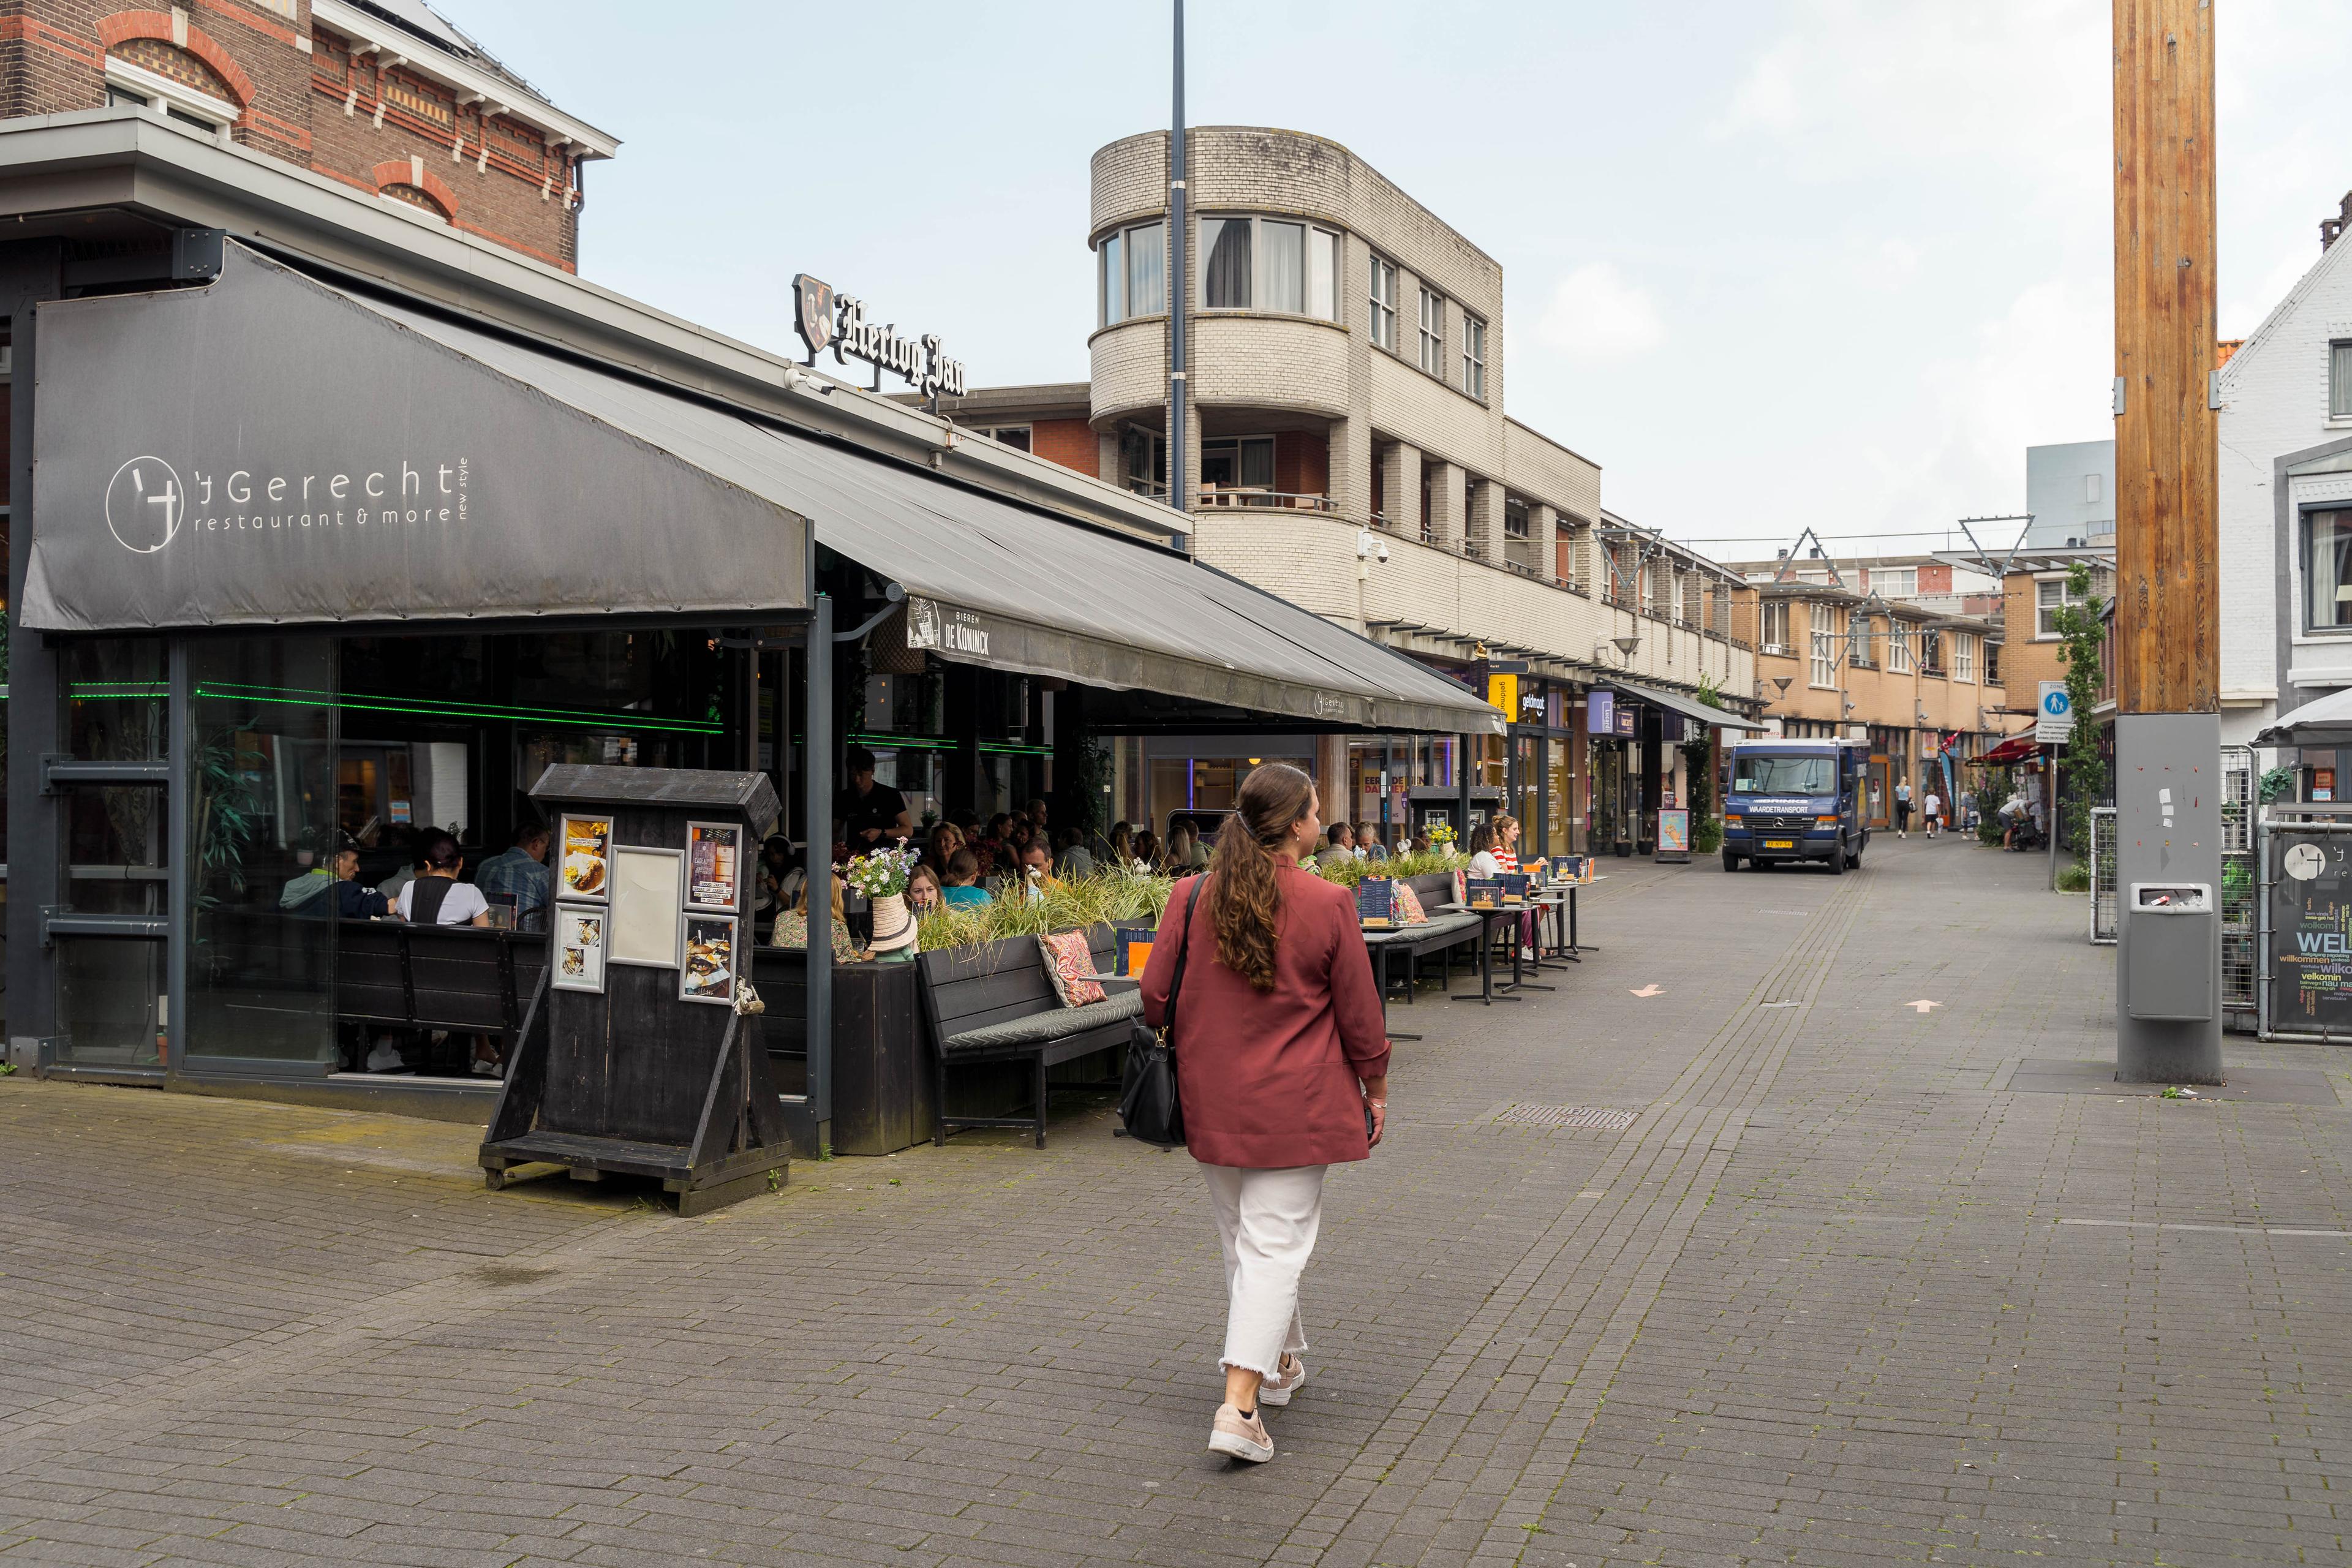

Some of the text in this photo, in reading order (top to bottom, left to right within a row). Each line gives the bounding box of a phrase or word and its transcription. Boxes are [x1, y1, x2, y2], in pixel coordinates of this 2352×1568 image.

[834, 293, 968, 398] Hertog Jan
[228, 461, 453, 503] Gerecht
[458, 457, 469, 488] style
[195, 508, 450, 531] restaurant & more
[956, 611, 979, 624] BIEREN
[945, 623, 990, 655] DE KONINCK
[1523, 694, 1545, 710] geldmaat
[2299, 921, 2334, 930] wolkom
[2279, 954, 2330, 963] willkommen
[2301, 973, 2342, 981] velkomin
